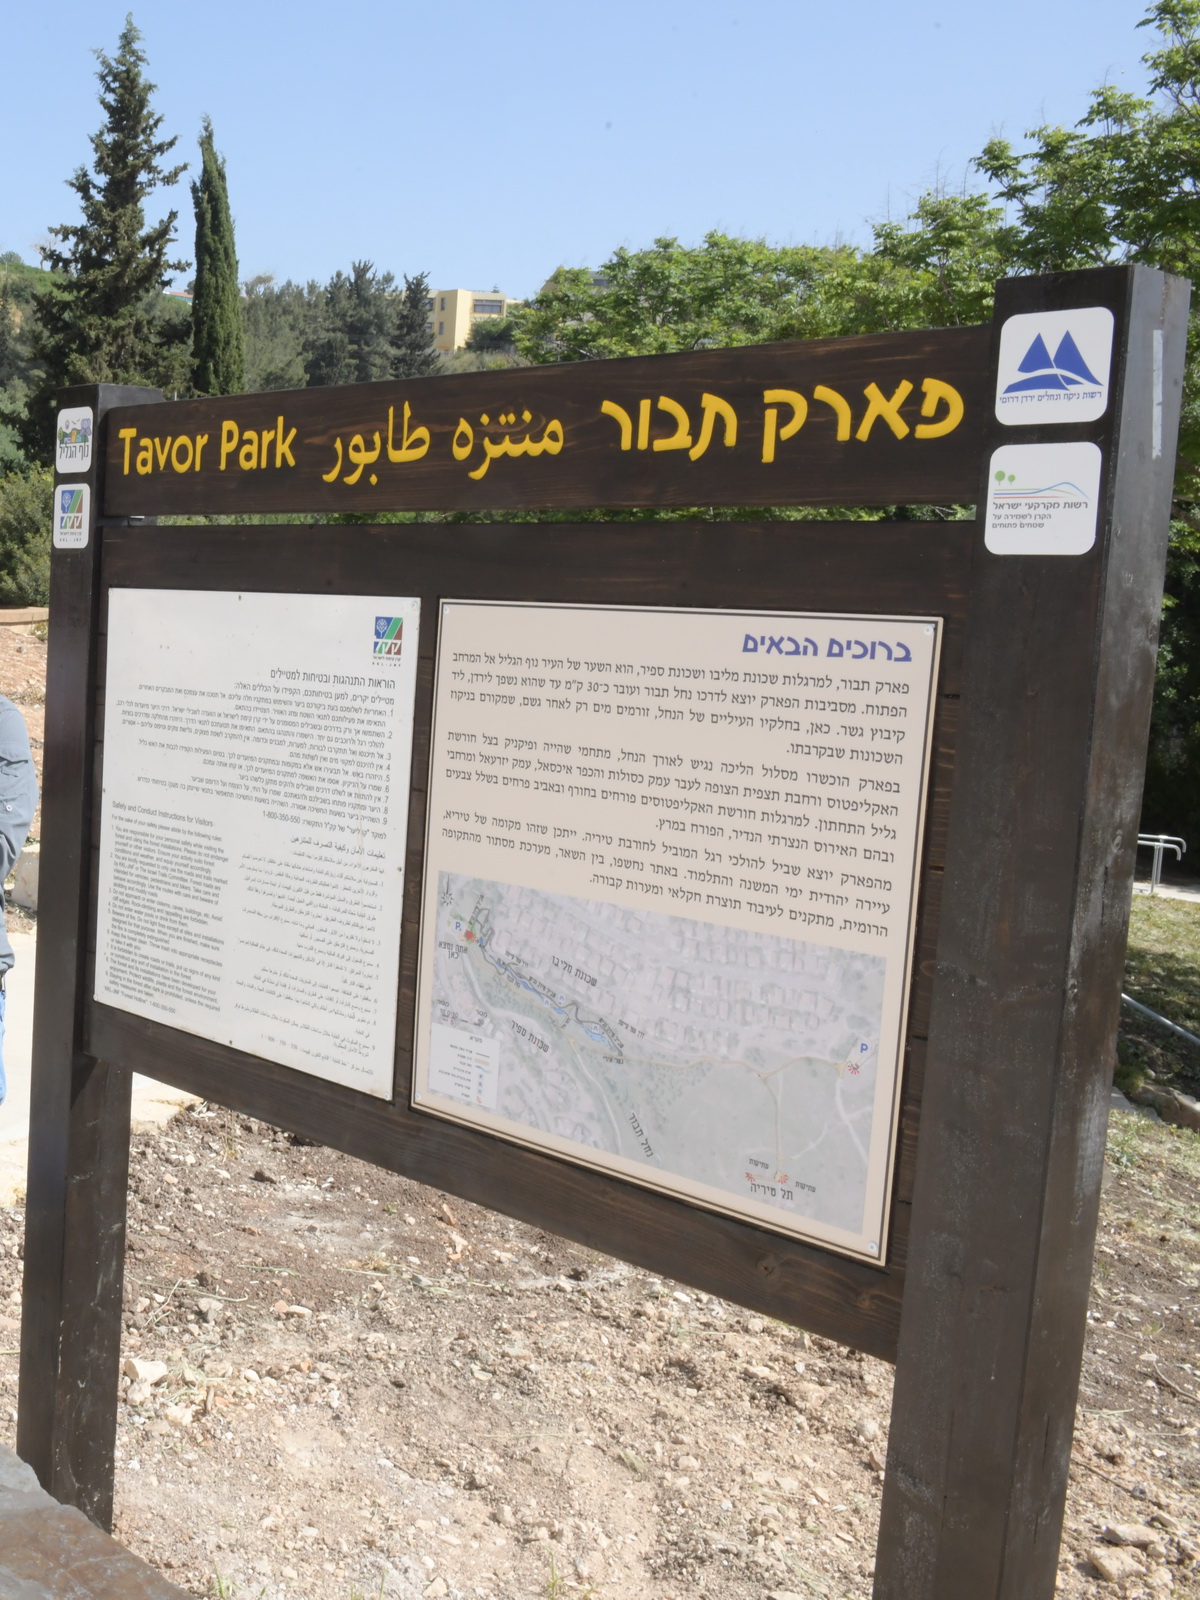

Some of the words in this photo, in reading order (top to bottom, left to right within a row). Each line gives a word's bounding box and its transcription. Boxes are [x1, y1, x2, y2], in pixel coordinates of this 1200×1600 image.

[601, 393, 738, 461] תבור
[761, 377, 965, 463] פארק
[118, 427, 209, 476] Tavor
[219, 415, 298, 471] Park
[322, 400, 430, 486] طابور
[452, 410, 564, 480] منتزه
[58, 442, 77, 460] הגליל
[79, 443, 90, 461] נוף
[992, 501, 1022, 510] ישראל
[1025, 501, 1060, 511] מקרקעי
[1062, 501, 1088, 509] רשות
[1004, 512, 1032, 520] לשמירה
[741, 633, 818, 657] הבאים
[825, 637, 912, 662] ברוכים
[452, 651, 481, 663] המרחב
[483, 651, 495, 664] אל
[497, 652, 522, 666] הגליל
[524, 657, 538, 669] נוף
[541, 658, 563, 669] העיר
[566, 657, 581, 671] של
[583, 660, 612, 672] השער
[614, 663, 633, 674] הוא
[636, 664, 665, 677] ספיר,
[667, 666, 705, 679] ושכונת
[269, 666, 301, 681] למטיילים
[301, 671, 331, 684] ובטיחות
[331, 673, 366, 687] התנהגות
[451, 668, 465, 680] ליד
[467, 670, 493, 684] לירדן,
[495, 674, 517, 686] נשפך
[708, 667, 739, 682] מליבו
[742, 671, 779, 685] שכונת
[781, 671, 832, 688] למרגלות
[366, 676, 396, 689] הוראות
[520, 676, 546, 688] שהוא
[548, 678, 561, 690] עד
[836, 678, 870, 691] תבור,
[874, 680, 909, 695] פארק
[449, 689, 475, 702] בניקוז
[612, 683, 640, 696] ועובר
[643, 685, 669, 698] תבור
[672, 685, 692, 700] נחל
[696, 688, 727, 702] לדרכו
[479, 692, 516, 705] שמקורם
[519, 695, 541, 707] גשם,
[545, 697, 571, 709] לאחר
[730, 692, 756, 705] יוצא
[760, 695, 800, 708] הפארק
[575, 700, 588, 713] רק
[592, 702, 611, 714] מים
[616, 704, 650, 717] זורמים
[654, 705, 684, 720] הנחל,
[803, 698, 856, 714] מסביבות
[860, 703, 907, 718] הפתוח.
[688, 707, 705, 723] של
[710, 711, 754, 727] העיליים
[759, 715, 800, 732] בחלקיו
[805, 721, 831, 735] כאן,
[836, 724, 864, 737] גשר.
[869, 727, 905, 744] קיבוץ
[785, 742, 845, 759] שבקרבתו.
[848, 748, 903, 765] השכונות
[111, 799, 127, 812] Safety
[126, 804, 137, 812] and
[136, 804, 157, 816] Conduct
[157, 809, 186, 822] Instructions
[185, 814, 194, 823] for
[193, 816, 214, 827] Visitors
[574, 968, 598, 987] שכונת
[510, 1020, 527, 1037] ספיר
[528, 1032, 550, 1053] שכונת
[750, 1183, 777, 1197] טיריה
[780, 1188, 793, 1200] תל
